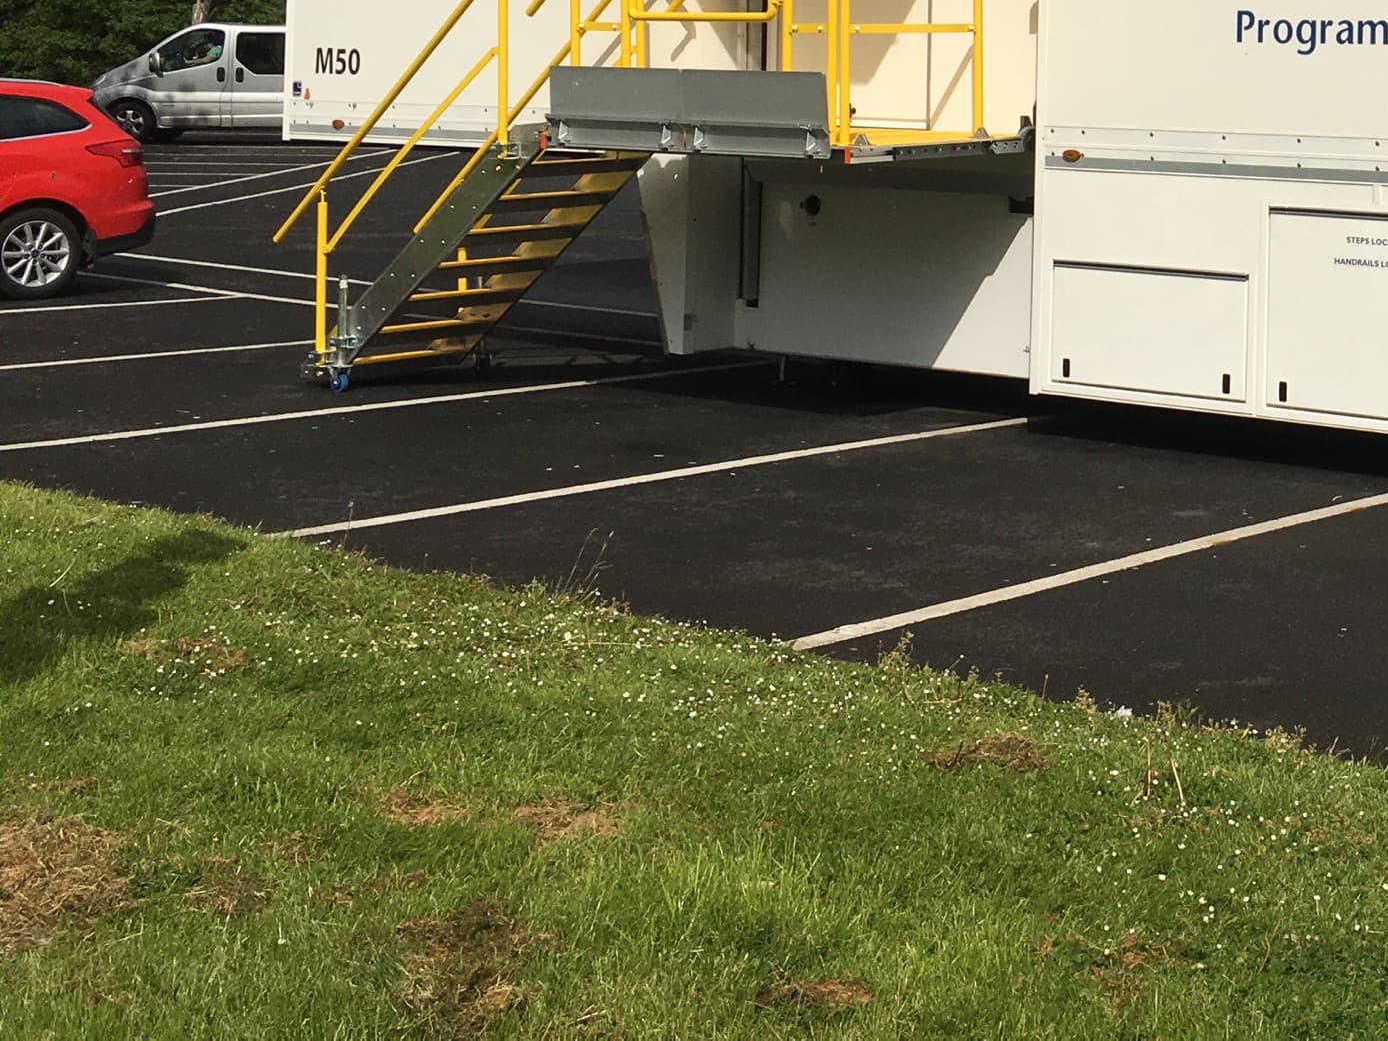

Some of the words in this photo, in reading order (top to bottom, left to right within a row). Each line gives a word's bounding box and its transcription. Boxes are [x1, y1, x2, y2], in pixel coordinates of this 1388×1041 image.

[315, 47, 361, 76] M50
[1346, 236, 1370, 246] STEPS
[1334, 257, 1380, 268] HANDRAILS
